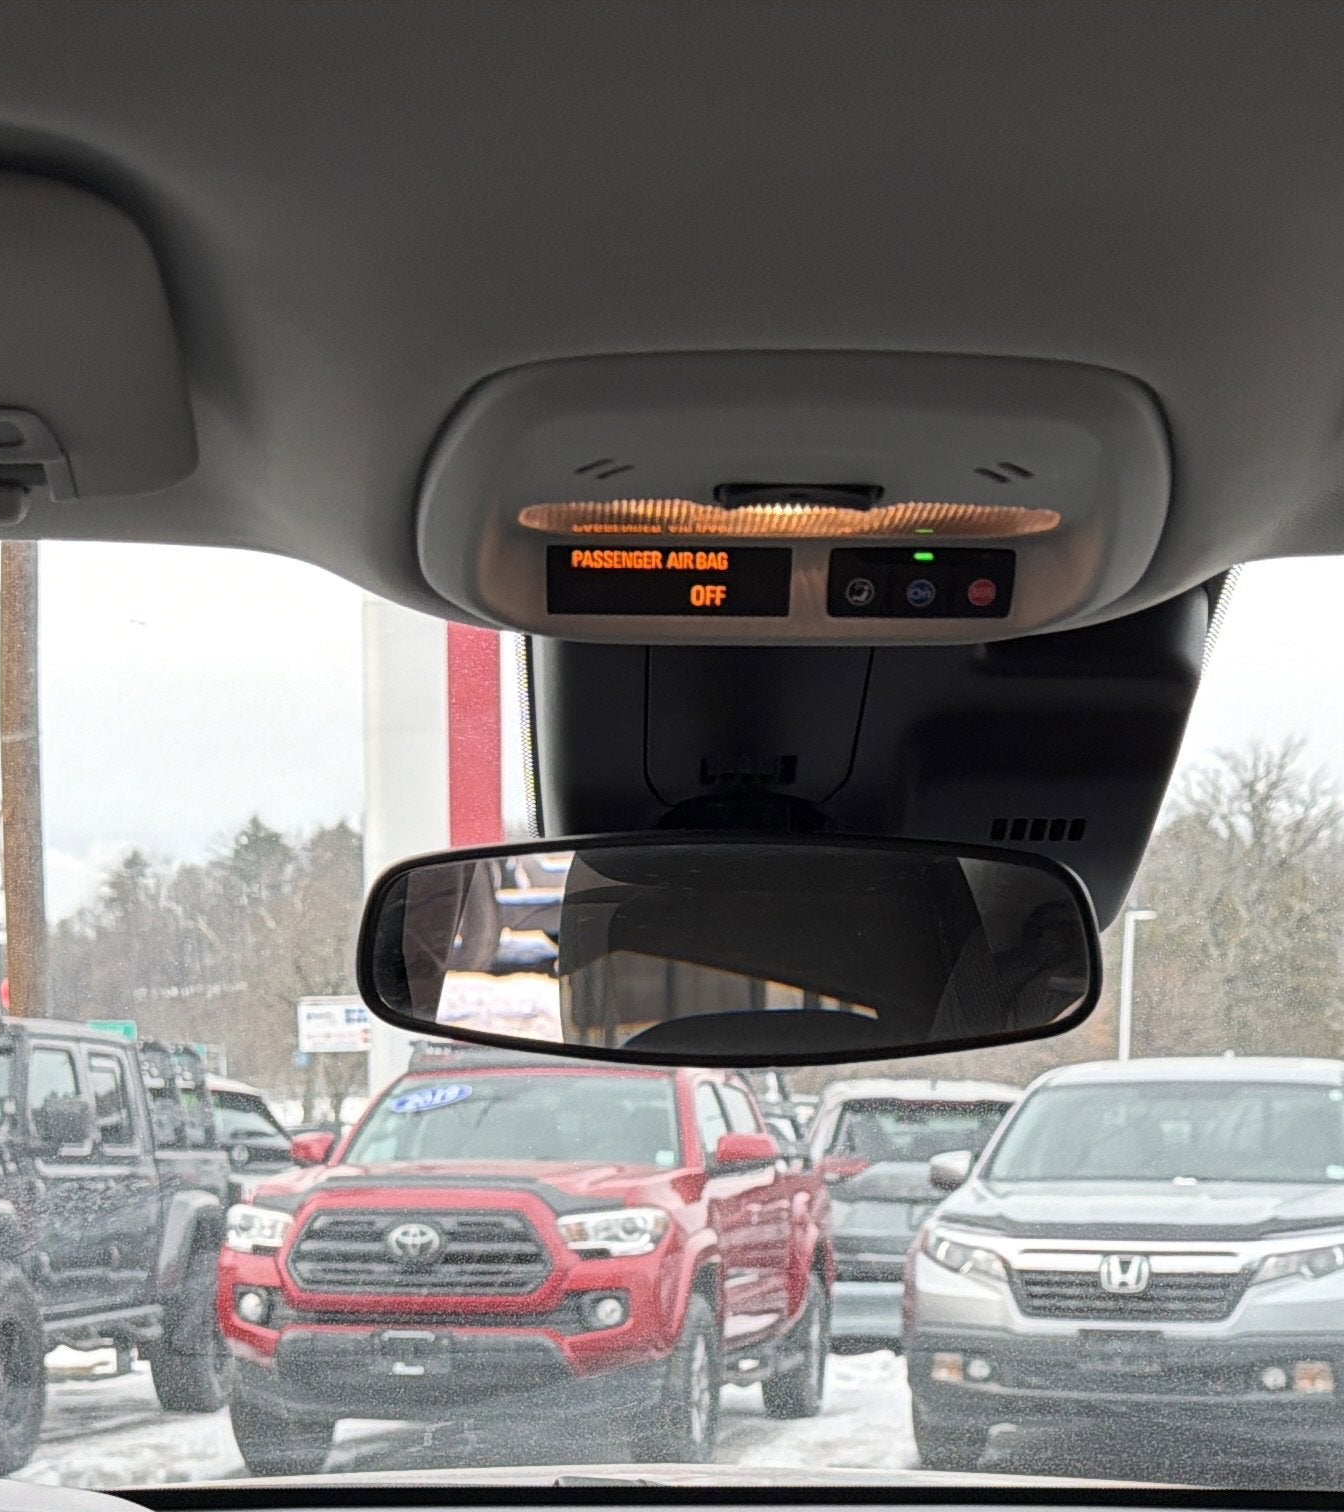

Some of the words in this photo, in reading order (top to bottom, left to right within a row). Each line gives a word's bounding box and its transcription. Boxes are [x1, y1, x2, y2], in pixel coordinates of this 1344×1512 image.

[571, 551, 663, 569] PASSENGER
[666, 552, 694, 570] AIR
[696, 552, 729, 571] BAG
[690, 585, 727, 607] OFF
